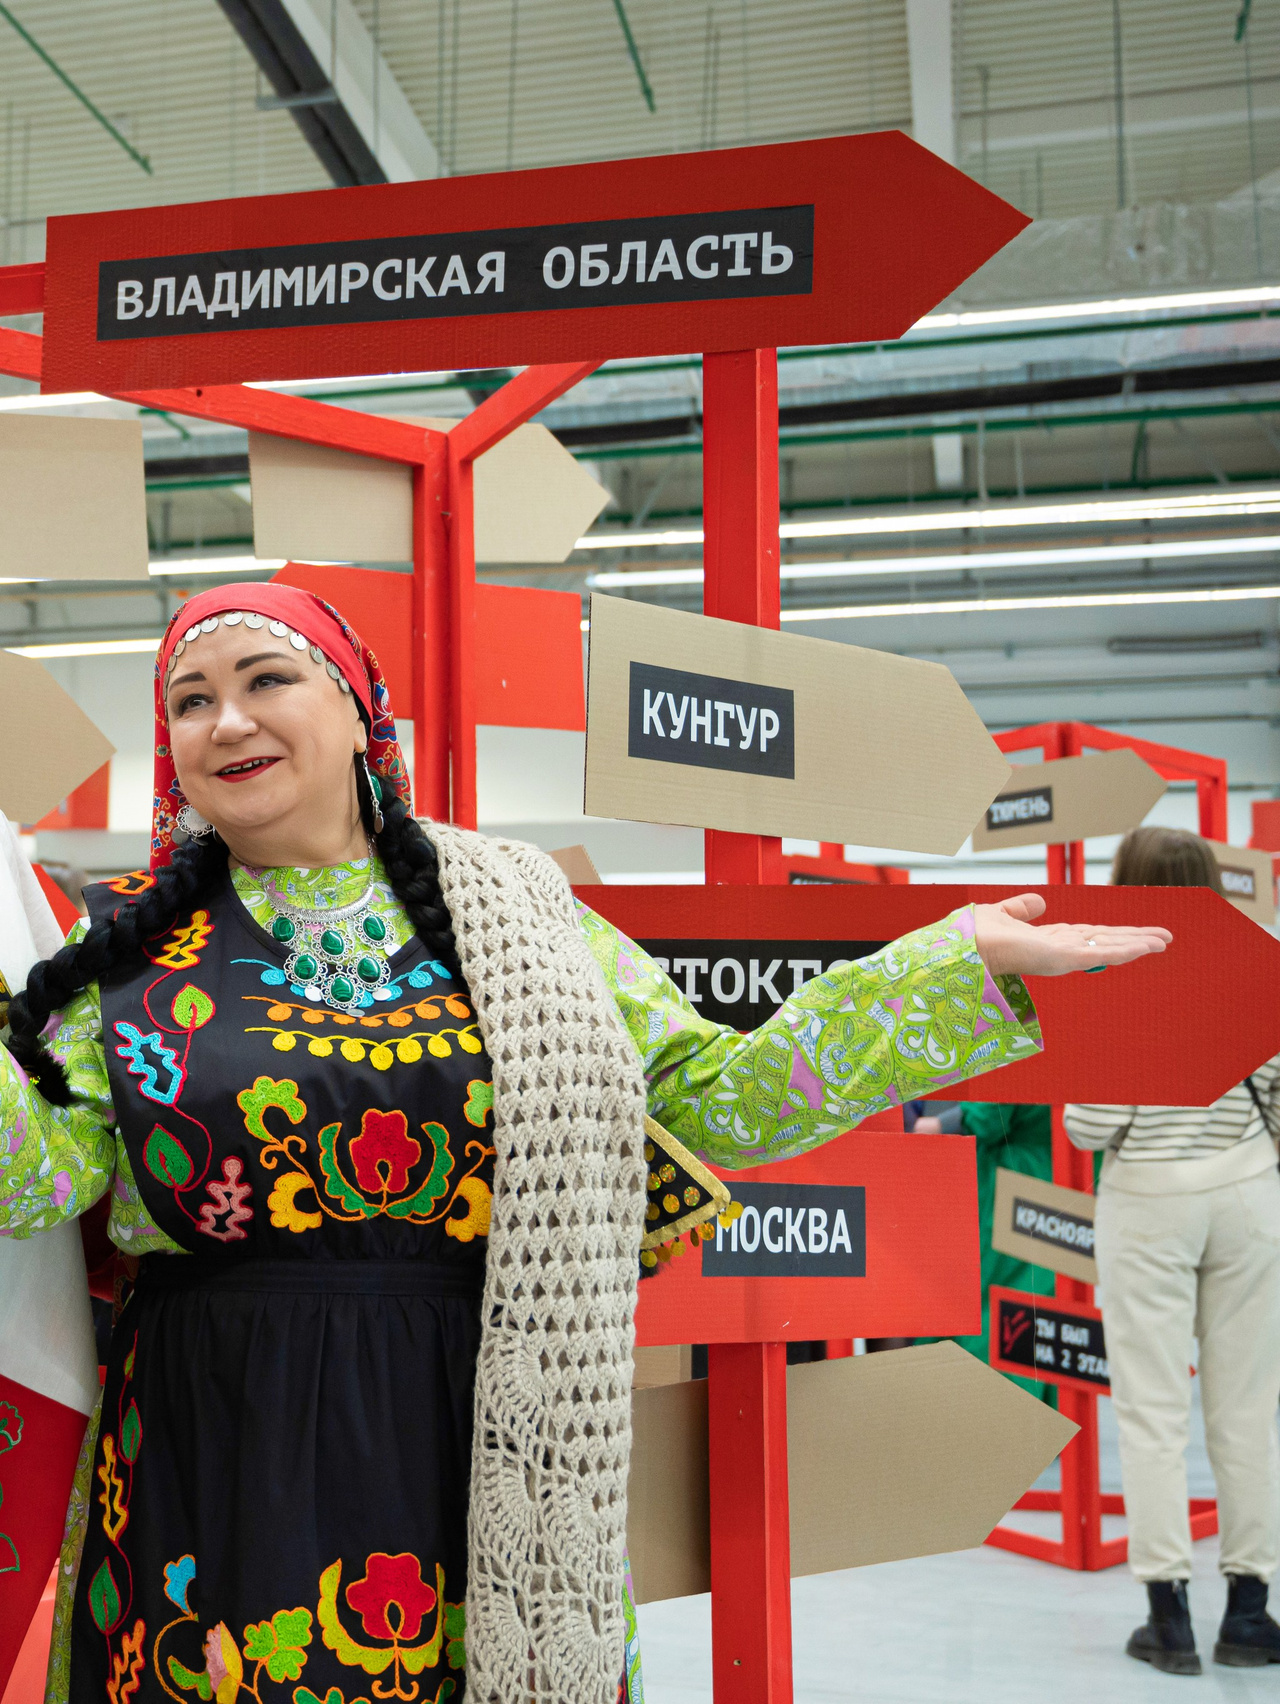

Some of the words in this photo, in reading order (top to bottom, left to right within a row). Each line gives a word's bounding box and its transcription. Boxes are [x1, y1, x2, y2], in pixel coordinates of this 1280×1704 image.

[116, 251, 506, 320] ВЛАДИМИРСКАЯ
[542, 231, 794, 290] ОБЛАСТЬ
[643, 688, 780, 753] КУНГУР
[1060, 1348, 1072, 1370] 2
